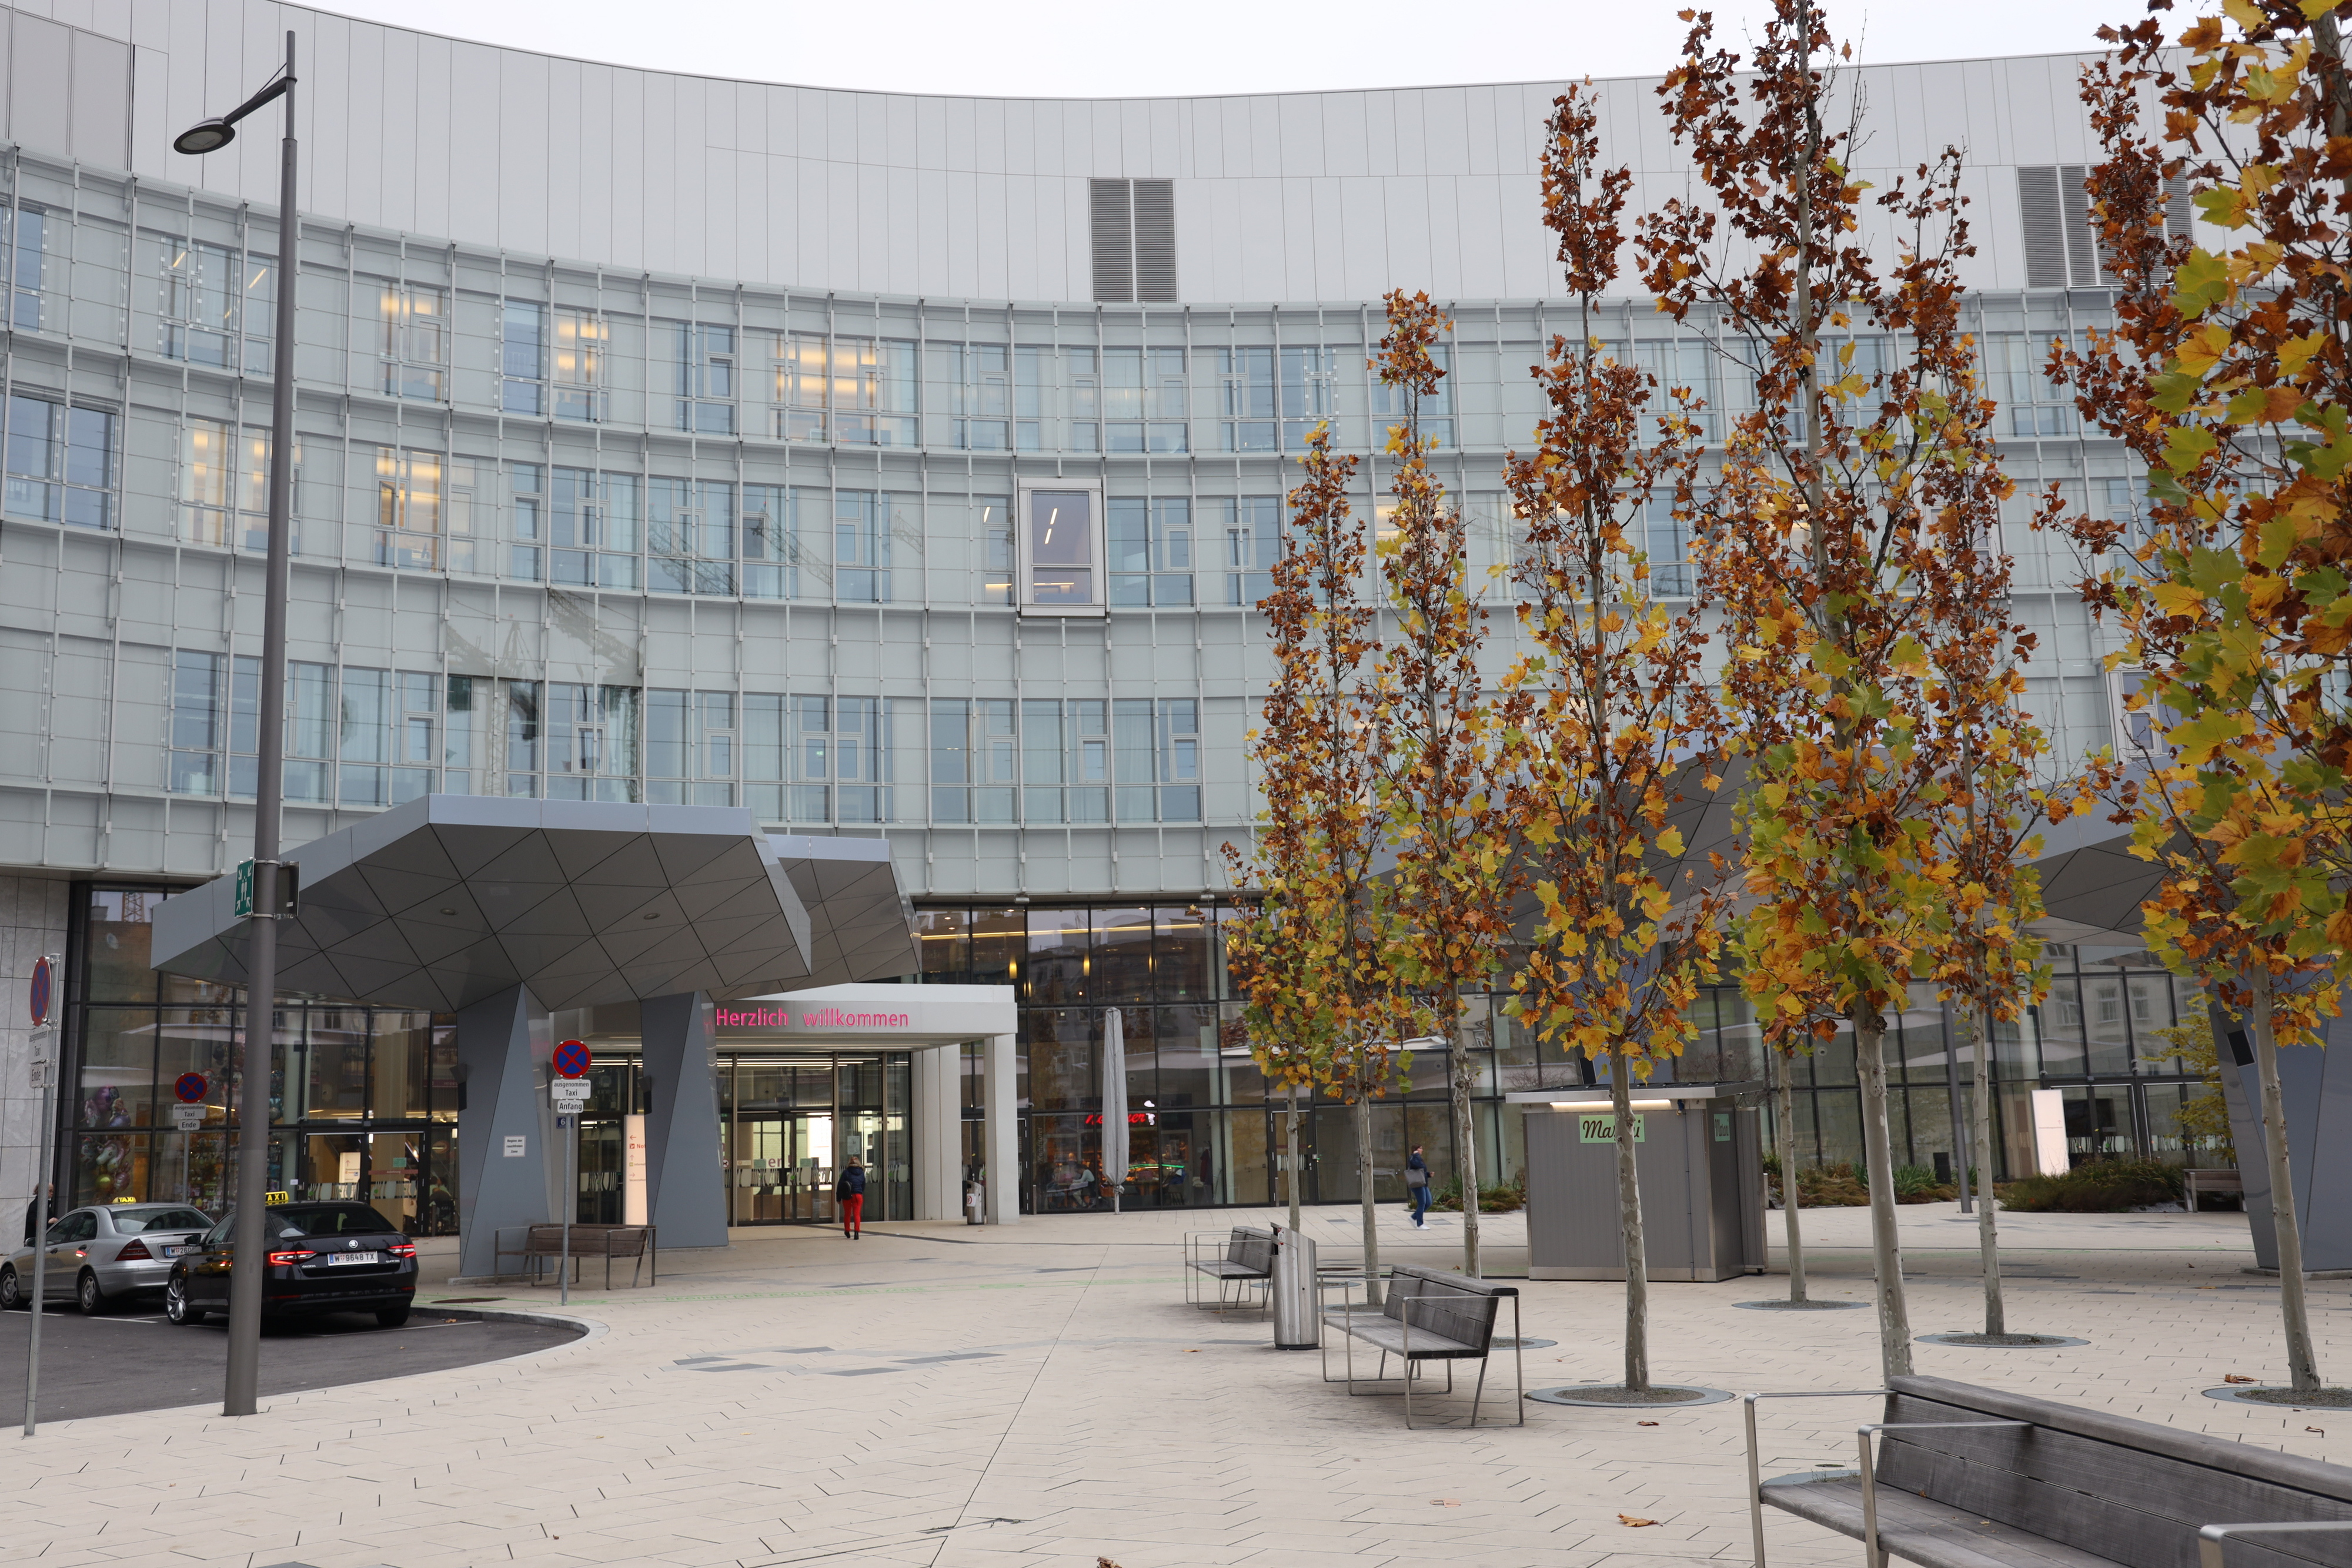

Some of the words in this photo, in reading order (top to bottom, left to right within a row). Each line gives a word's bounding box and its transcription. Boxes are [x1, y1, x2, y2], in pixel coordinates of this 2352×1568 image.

[716, 1008, 789, 1027] Herzlich
[803, 1008, 909, 1027] willkommen
[559, 1102, 582, 1111] Anfang
[266, 1192, 285, 1201] AXI
[345, 1252, 364, 1262] 9648
[366, 1252, 374, 1261] TX
